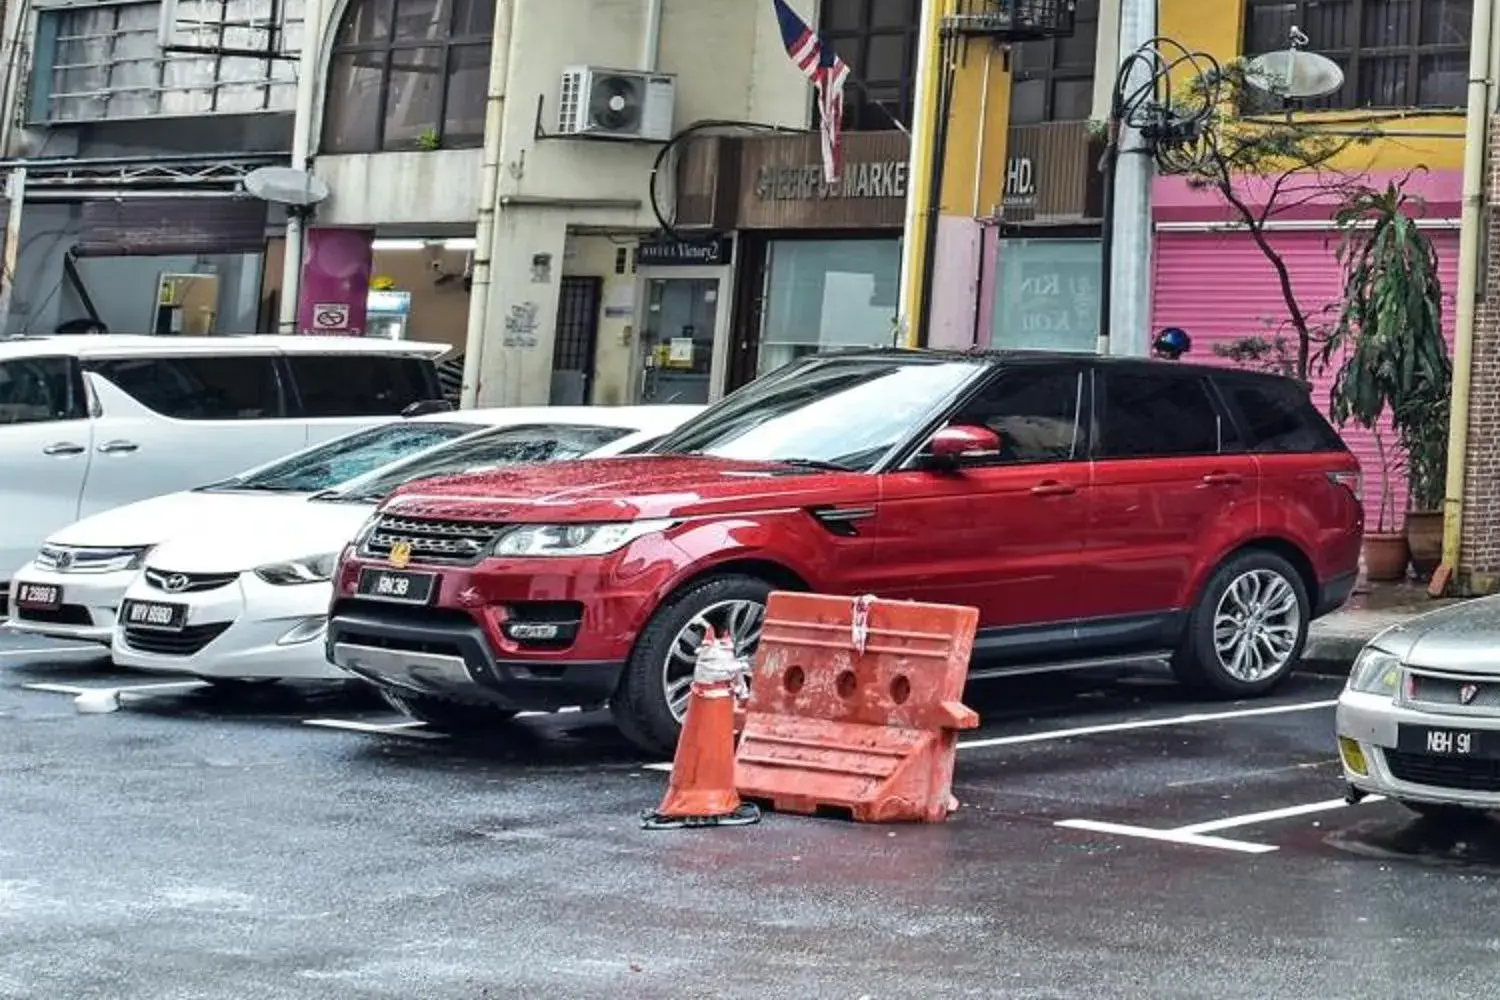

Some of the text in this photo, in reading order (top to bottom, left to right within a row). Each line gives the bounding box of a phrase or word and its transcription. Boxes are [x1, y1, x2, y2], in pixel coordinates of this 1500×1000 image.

[843, 161, 911, 197] MARKE
[1427, 731, 1471, 753] NBH 91
